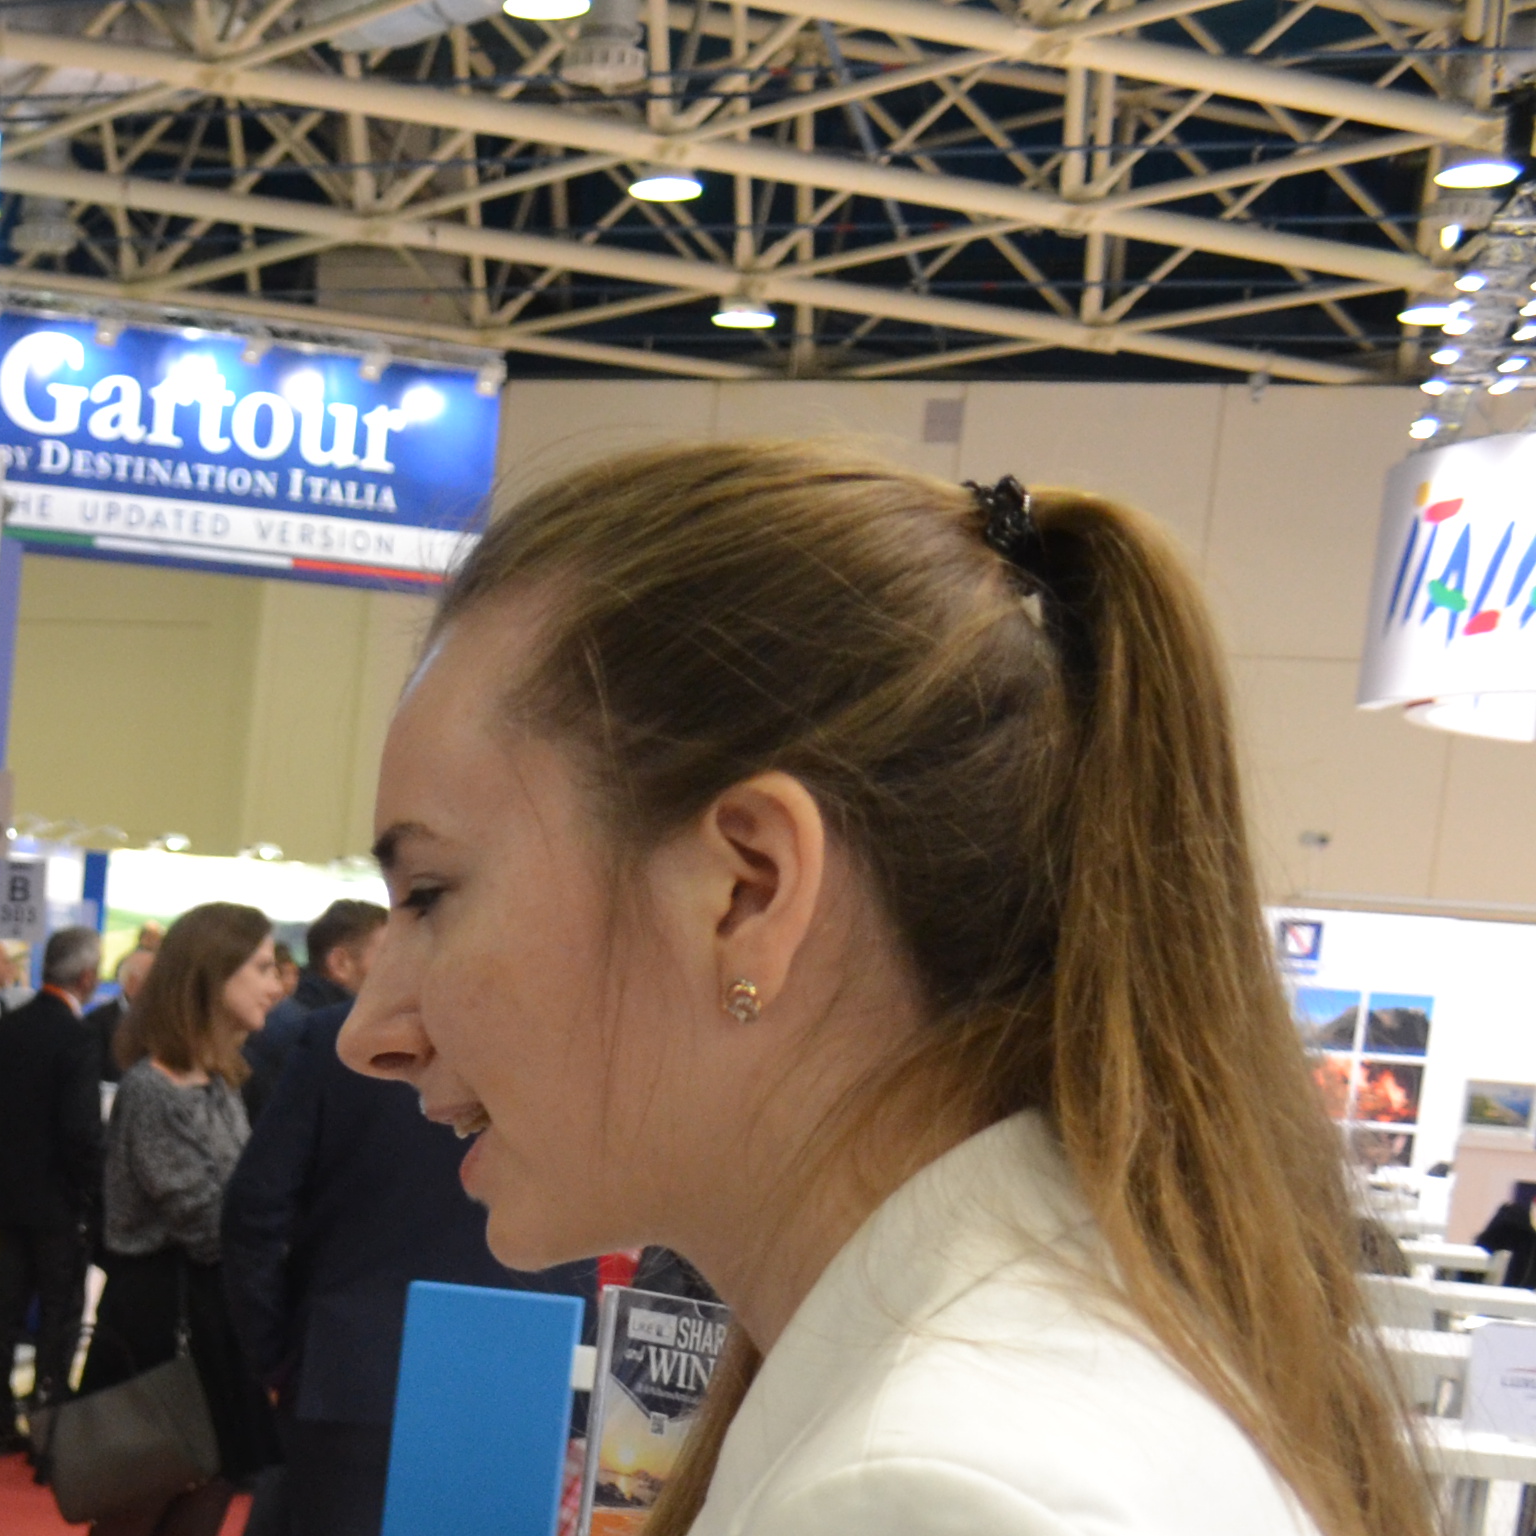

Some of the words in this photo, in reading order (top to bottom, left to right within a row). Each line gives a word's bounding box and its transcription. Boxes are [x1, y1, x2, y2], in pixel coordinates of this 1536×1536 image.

[39, 440, 278, 499] DESTINATION
[287, 469, 397, 513] ITALIA
[7, 492, 54, 521] HE
[79, 498, 231, 540] UPDATED
[257, 519, 395, 557] VERSION
[9, 876, 30, 901] B
[678, 1316, 728, 1355] SHAR
